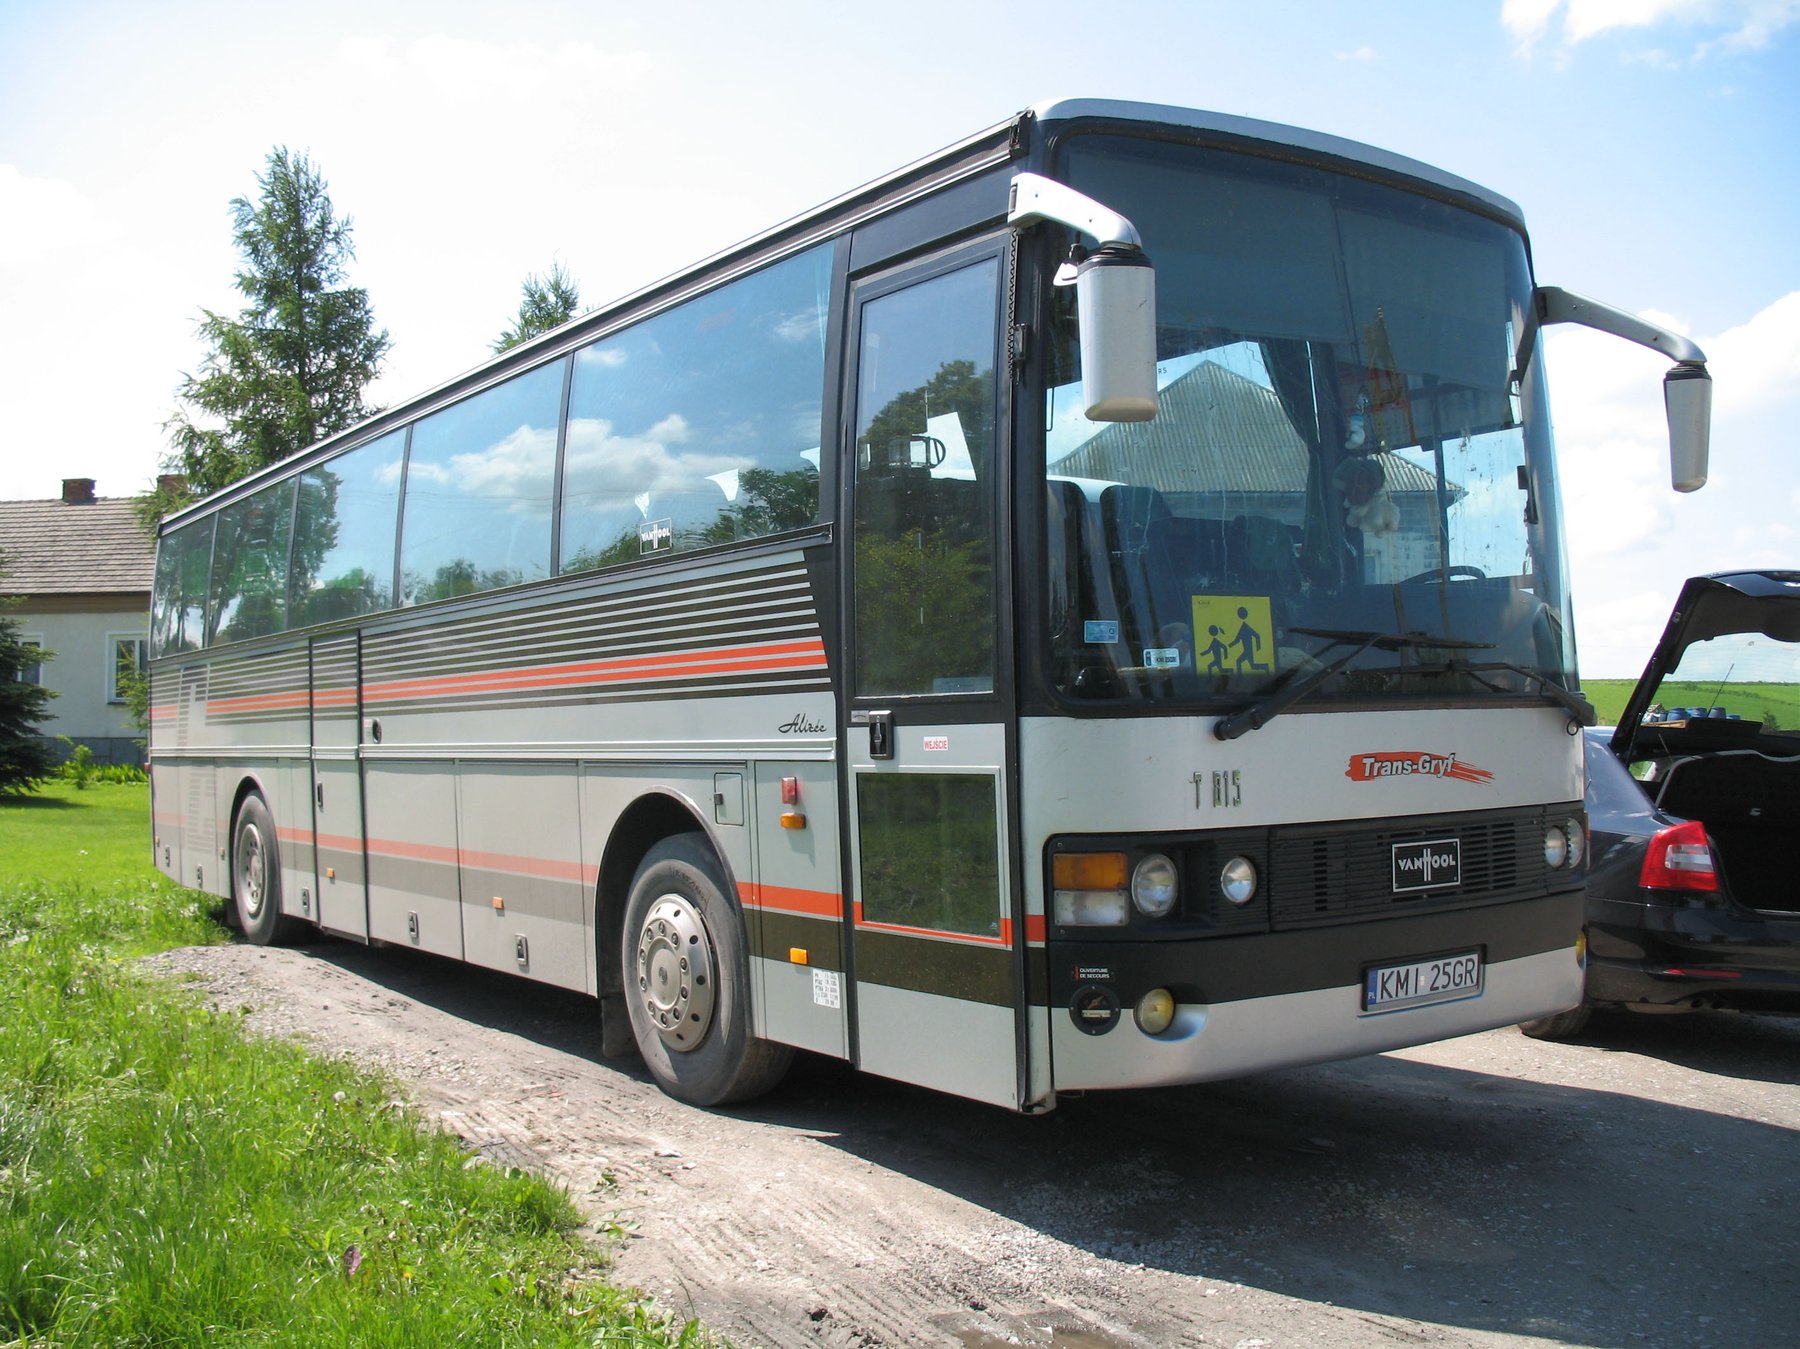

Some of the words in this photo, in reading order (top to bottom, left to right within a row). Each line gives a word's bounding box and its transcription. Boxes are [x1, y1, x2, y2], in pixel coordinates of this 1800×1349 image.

[924, 738, 947, 750] WEJŚCIE
[1362, 752, 1456, 778] Trans-Gryf
[1380, 967, 1419, 1000] KMI
[1429, 957, 1475, 992] 25GR
[1368, 991, 1376, 1000] PL
